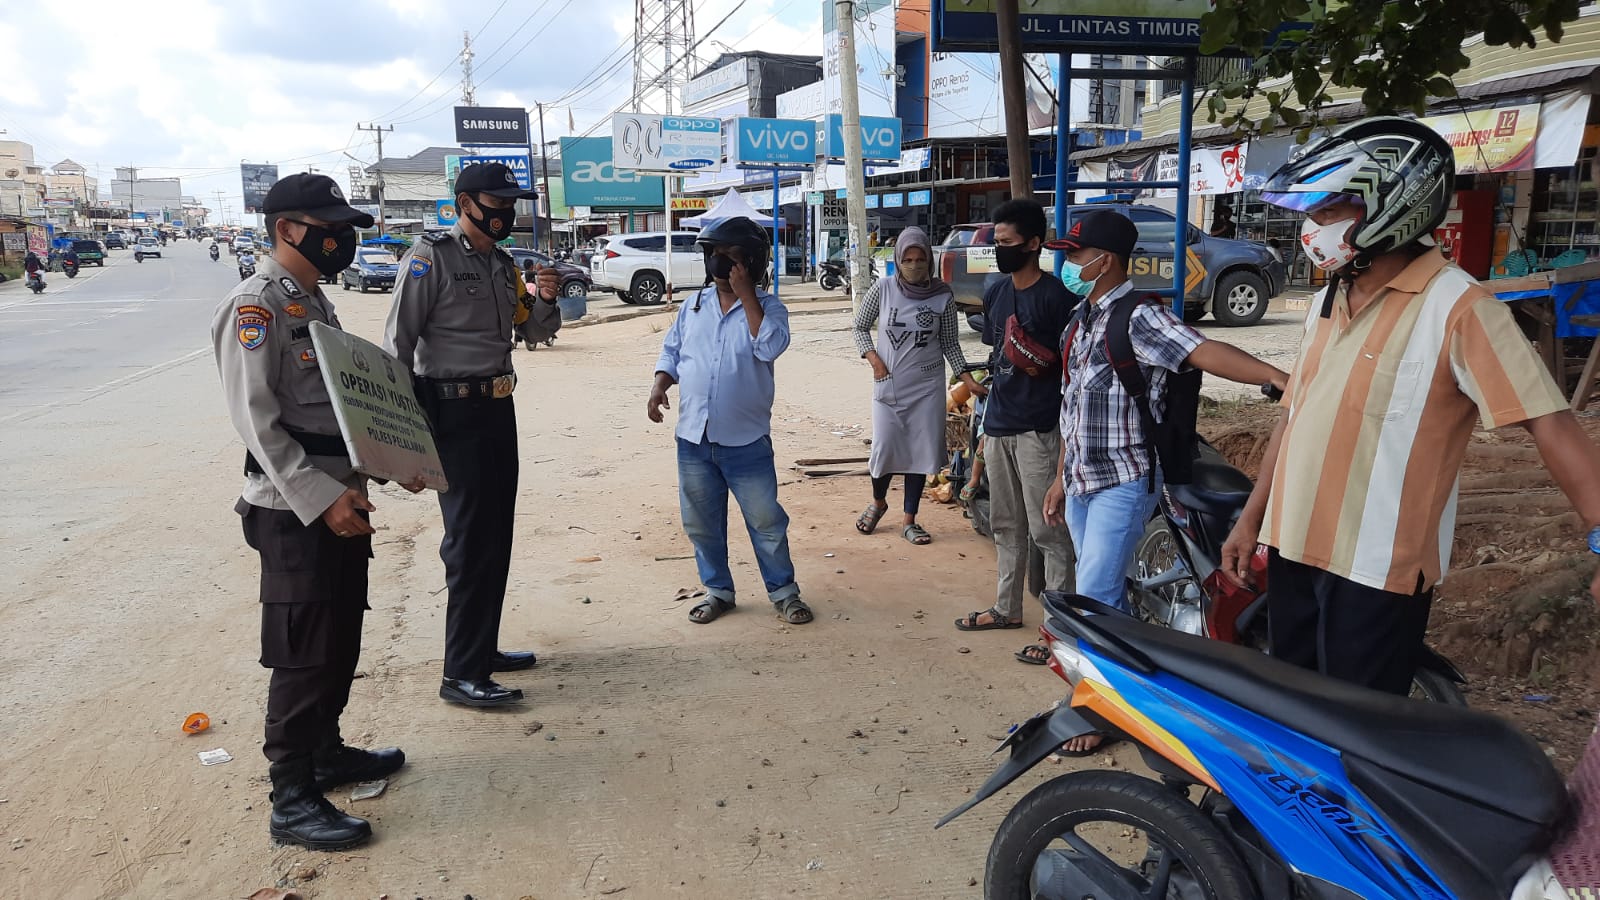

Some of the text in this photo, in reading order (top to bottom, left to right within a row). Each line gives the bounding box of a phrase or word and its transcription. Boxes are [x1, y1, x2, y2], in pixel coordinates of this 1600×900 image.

[1022, 18, 1200, 36] JL. LINTAS TIMUR
[463, 120, 519, 130] SAMSUNG
[667, 119, 716, 130] oppo
[1500, 112, 1516, 129] 12
[746, 123, 808, 150] vivo
[682, 199, 706, 208] KITA
[823, 206, 848, 217] REN
[340, 371, 387, 402] OPERASI
